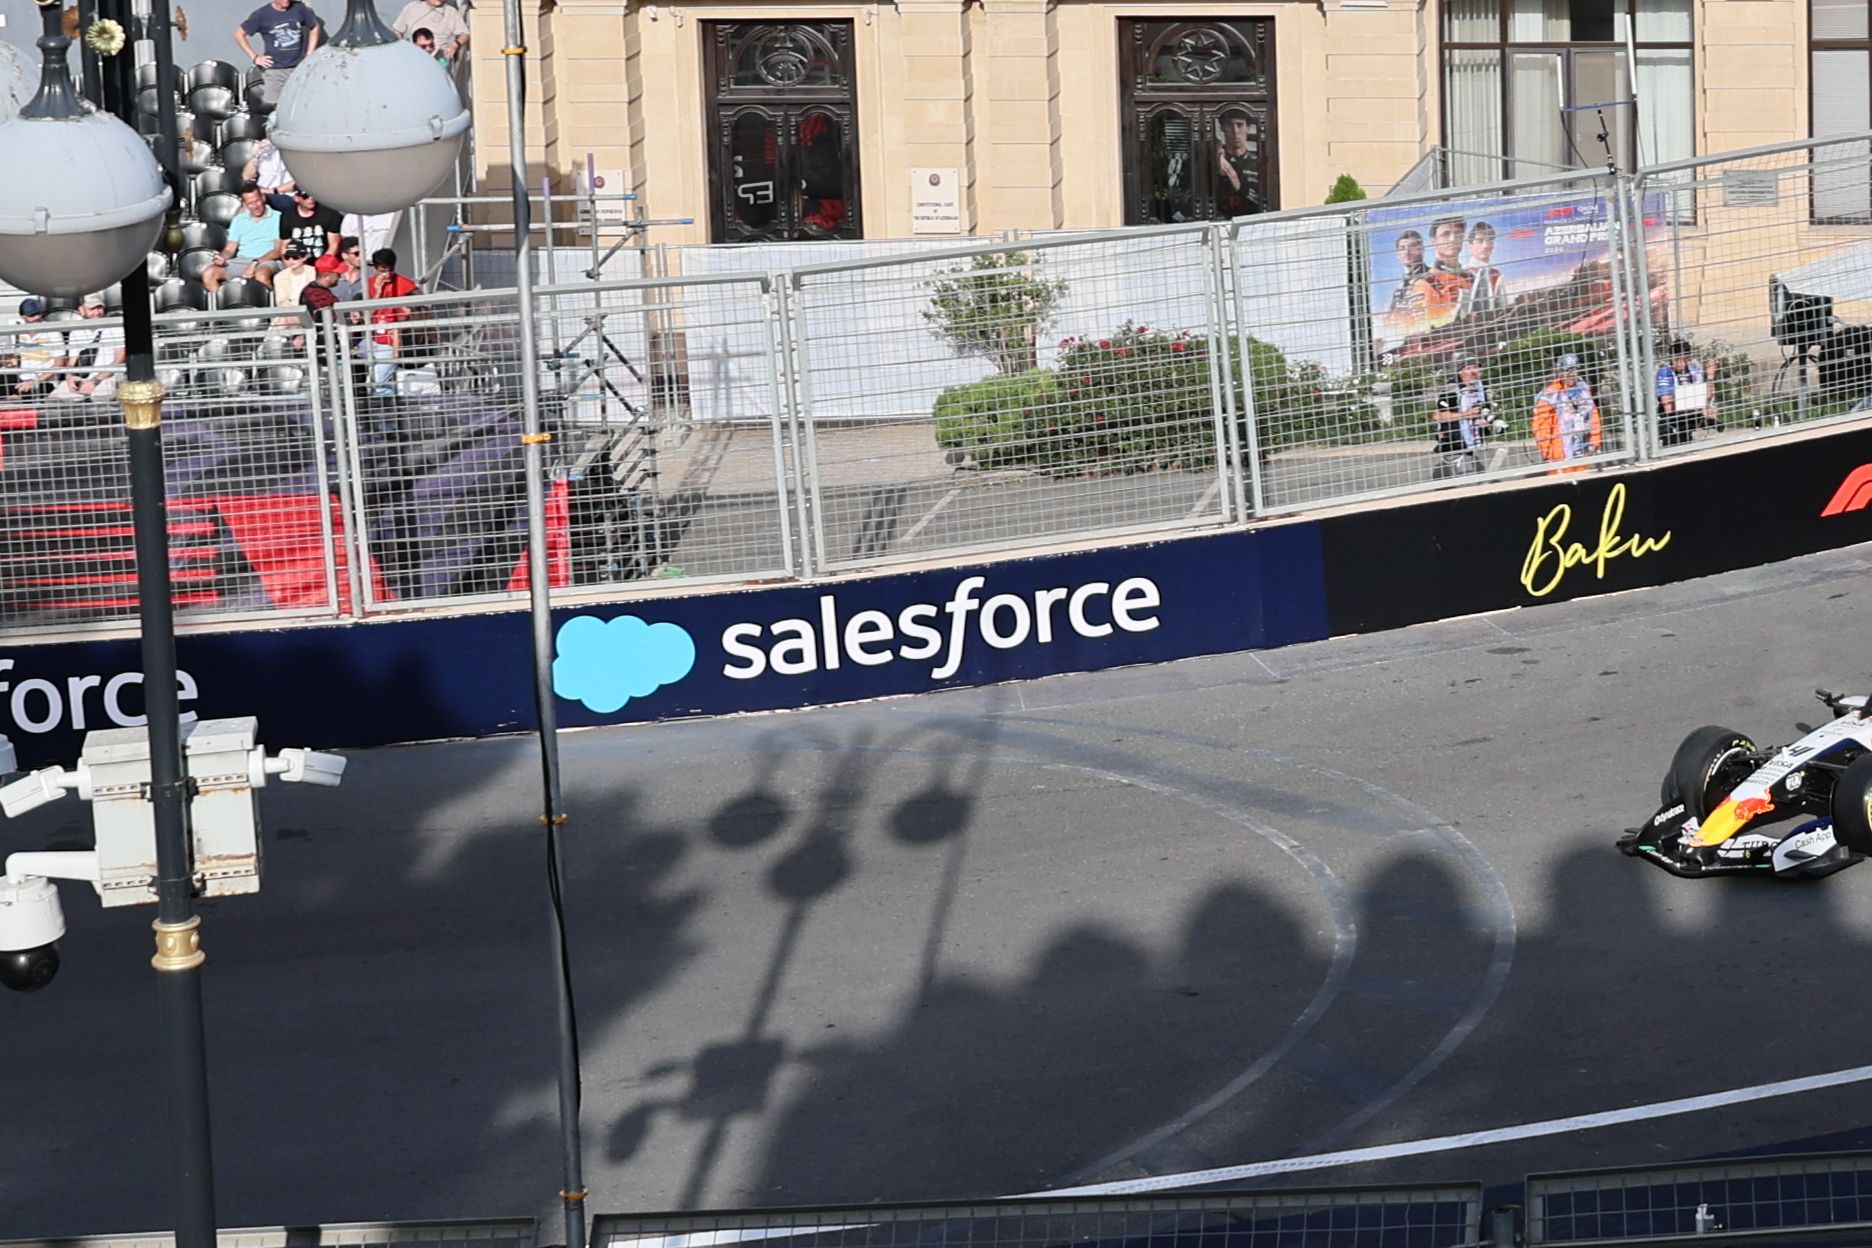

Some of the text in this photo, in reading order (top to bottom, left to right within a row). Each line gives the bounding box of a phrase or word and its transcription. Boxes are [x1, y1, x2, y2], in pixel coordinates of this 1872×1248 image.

[1544, 233, 1588, 245] GRAND
[1520, 483, 1671, 596] Baku
[722, 576, 1161, 680] salesforce
[1795, 832, 1832, 849] Cash App
